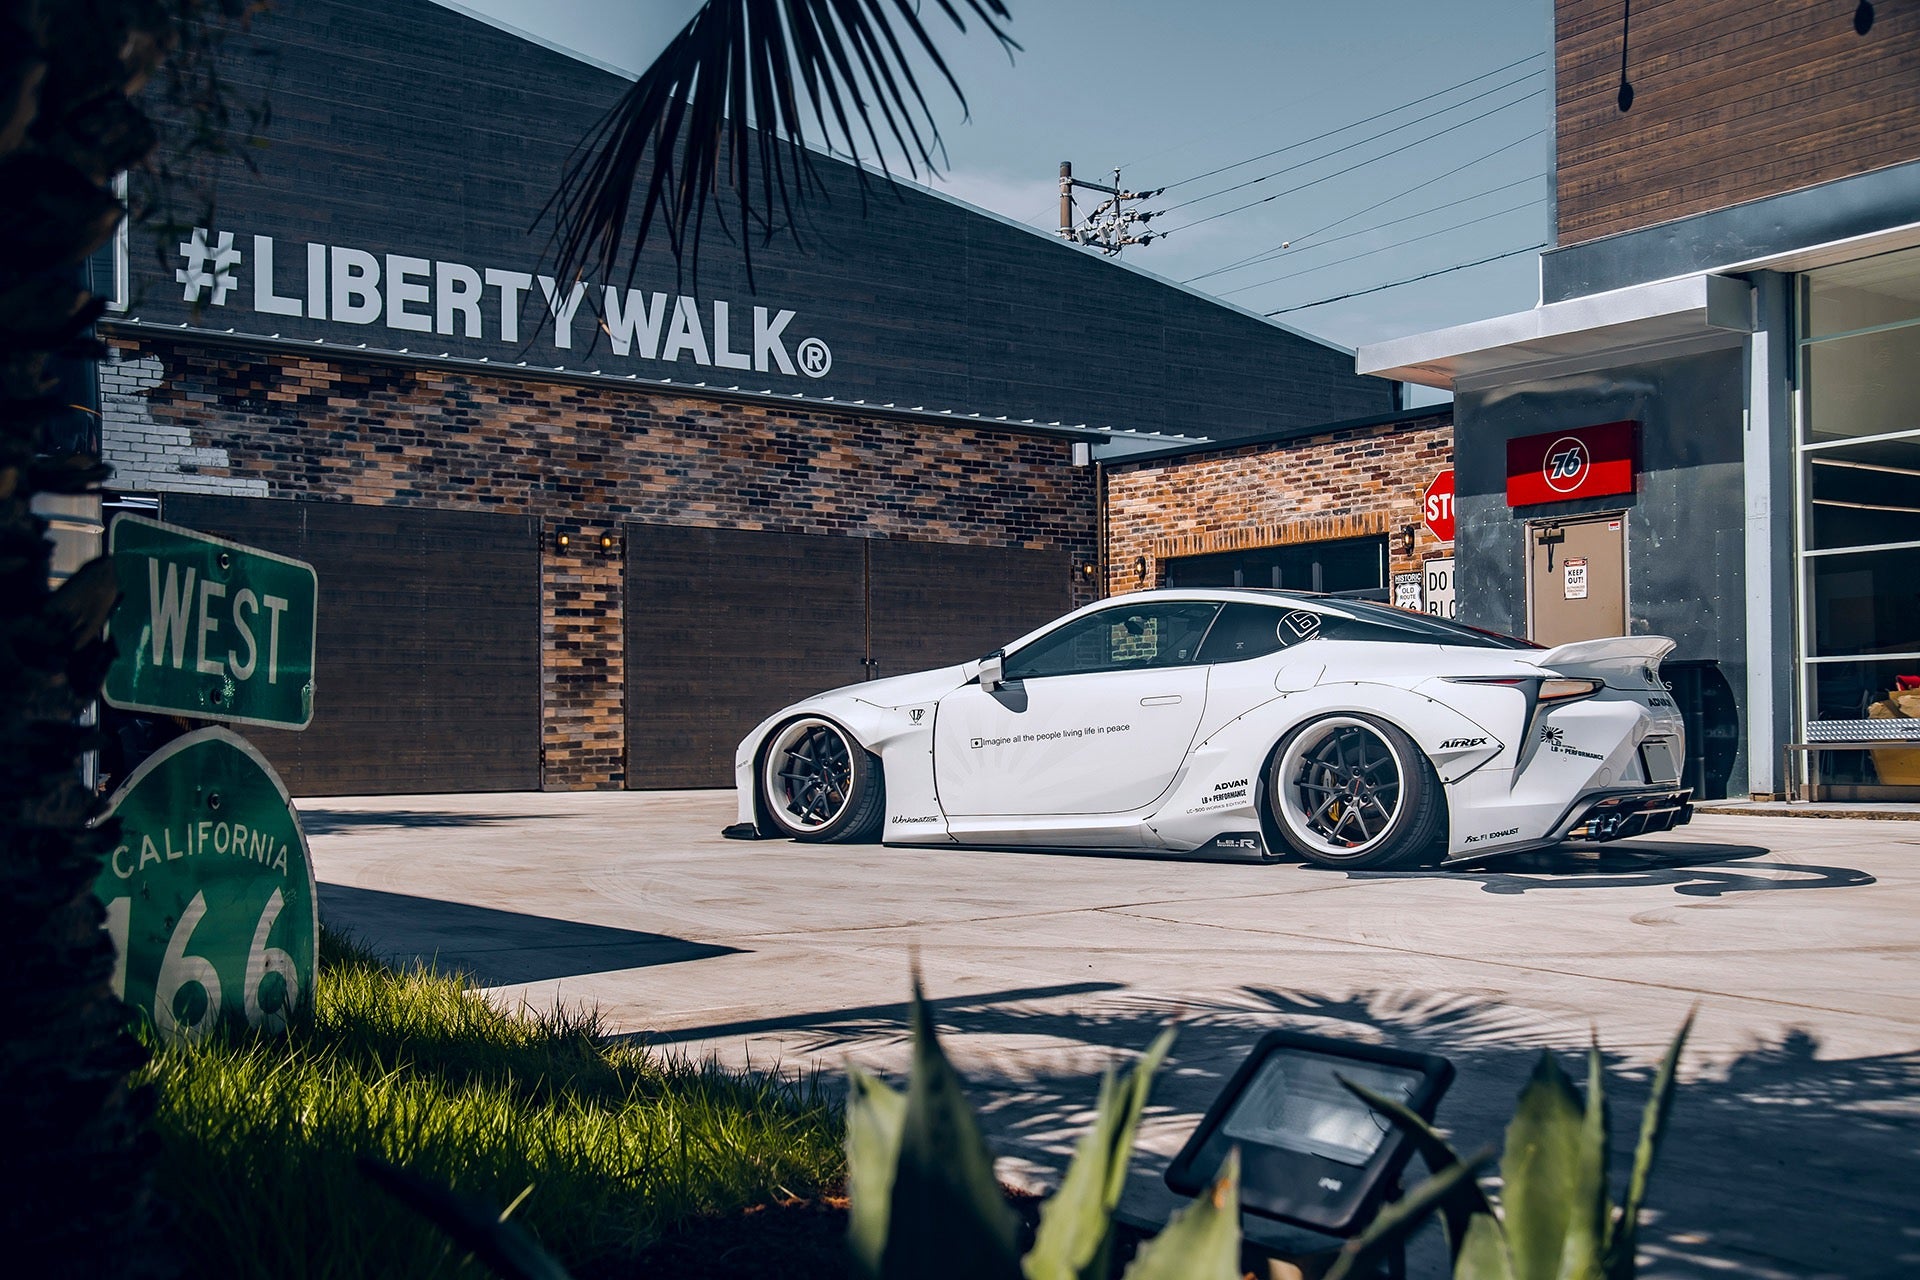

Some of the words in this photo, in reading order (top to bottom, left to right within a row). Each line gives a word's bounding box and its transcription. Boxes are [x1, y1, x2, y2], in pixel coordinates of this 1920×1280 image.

[1551, 447, 1581, 479] 76
[1427, 493, 1455, 521] ST
[1429, 571, 1447, 591] DO
[1568, 569, 1584, 577] KEEP
[149, 557, 288, 684] WEST
[983, 736, 1011, 746] Imagine
[1013, 735, 1021, 743] all
[1023, 734, 1035, 742] the
[1036, 731, 1061, 742] people
[1063, 729, 1083, 737] living
[1084, 726, 1096, 735] life
[1097, 726, 1105, 734] in
[1106, 724, 1130, 734] peace
[1564, 748, 1604, 760] PERFORMANCE
[1214, 778, 1249, 791] ADVAN
[1201, 796, 1209, 804] LB
[1213, 789, 1247, 802] PERFORMANCE
[1489, 827, 1519, 839] EXHAUST
[112, 821, 288, 879] CALIFORNIA
